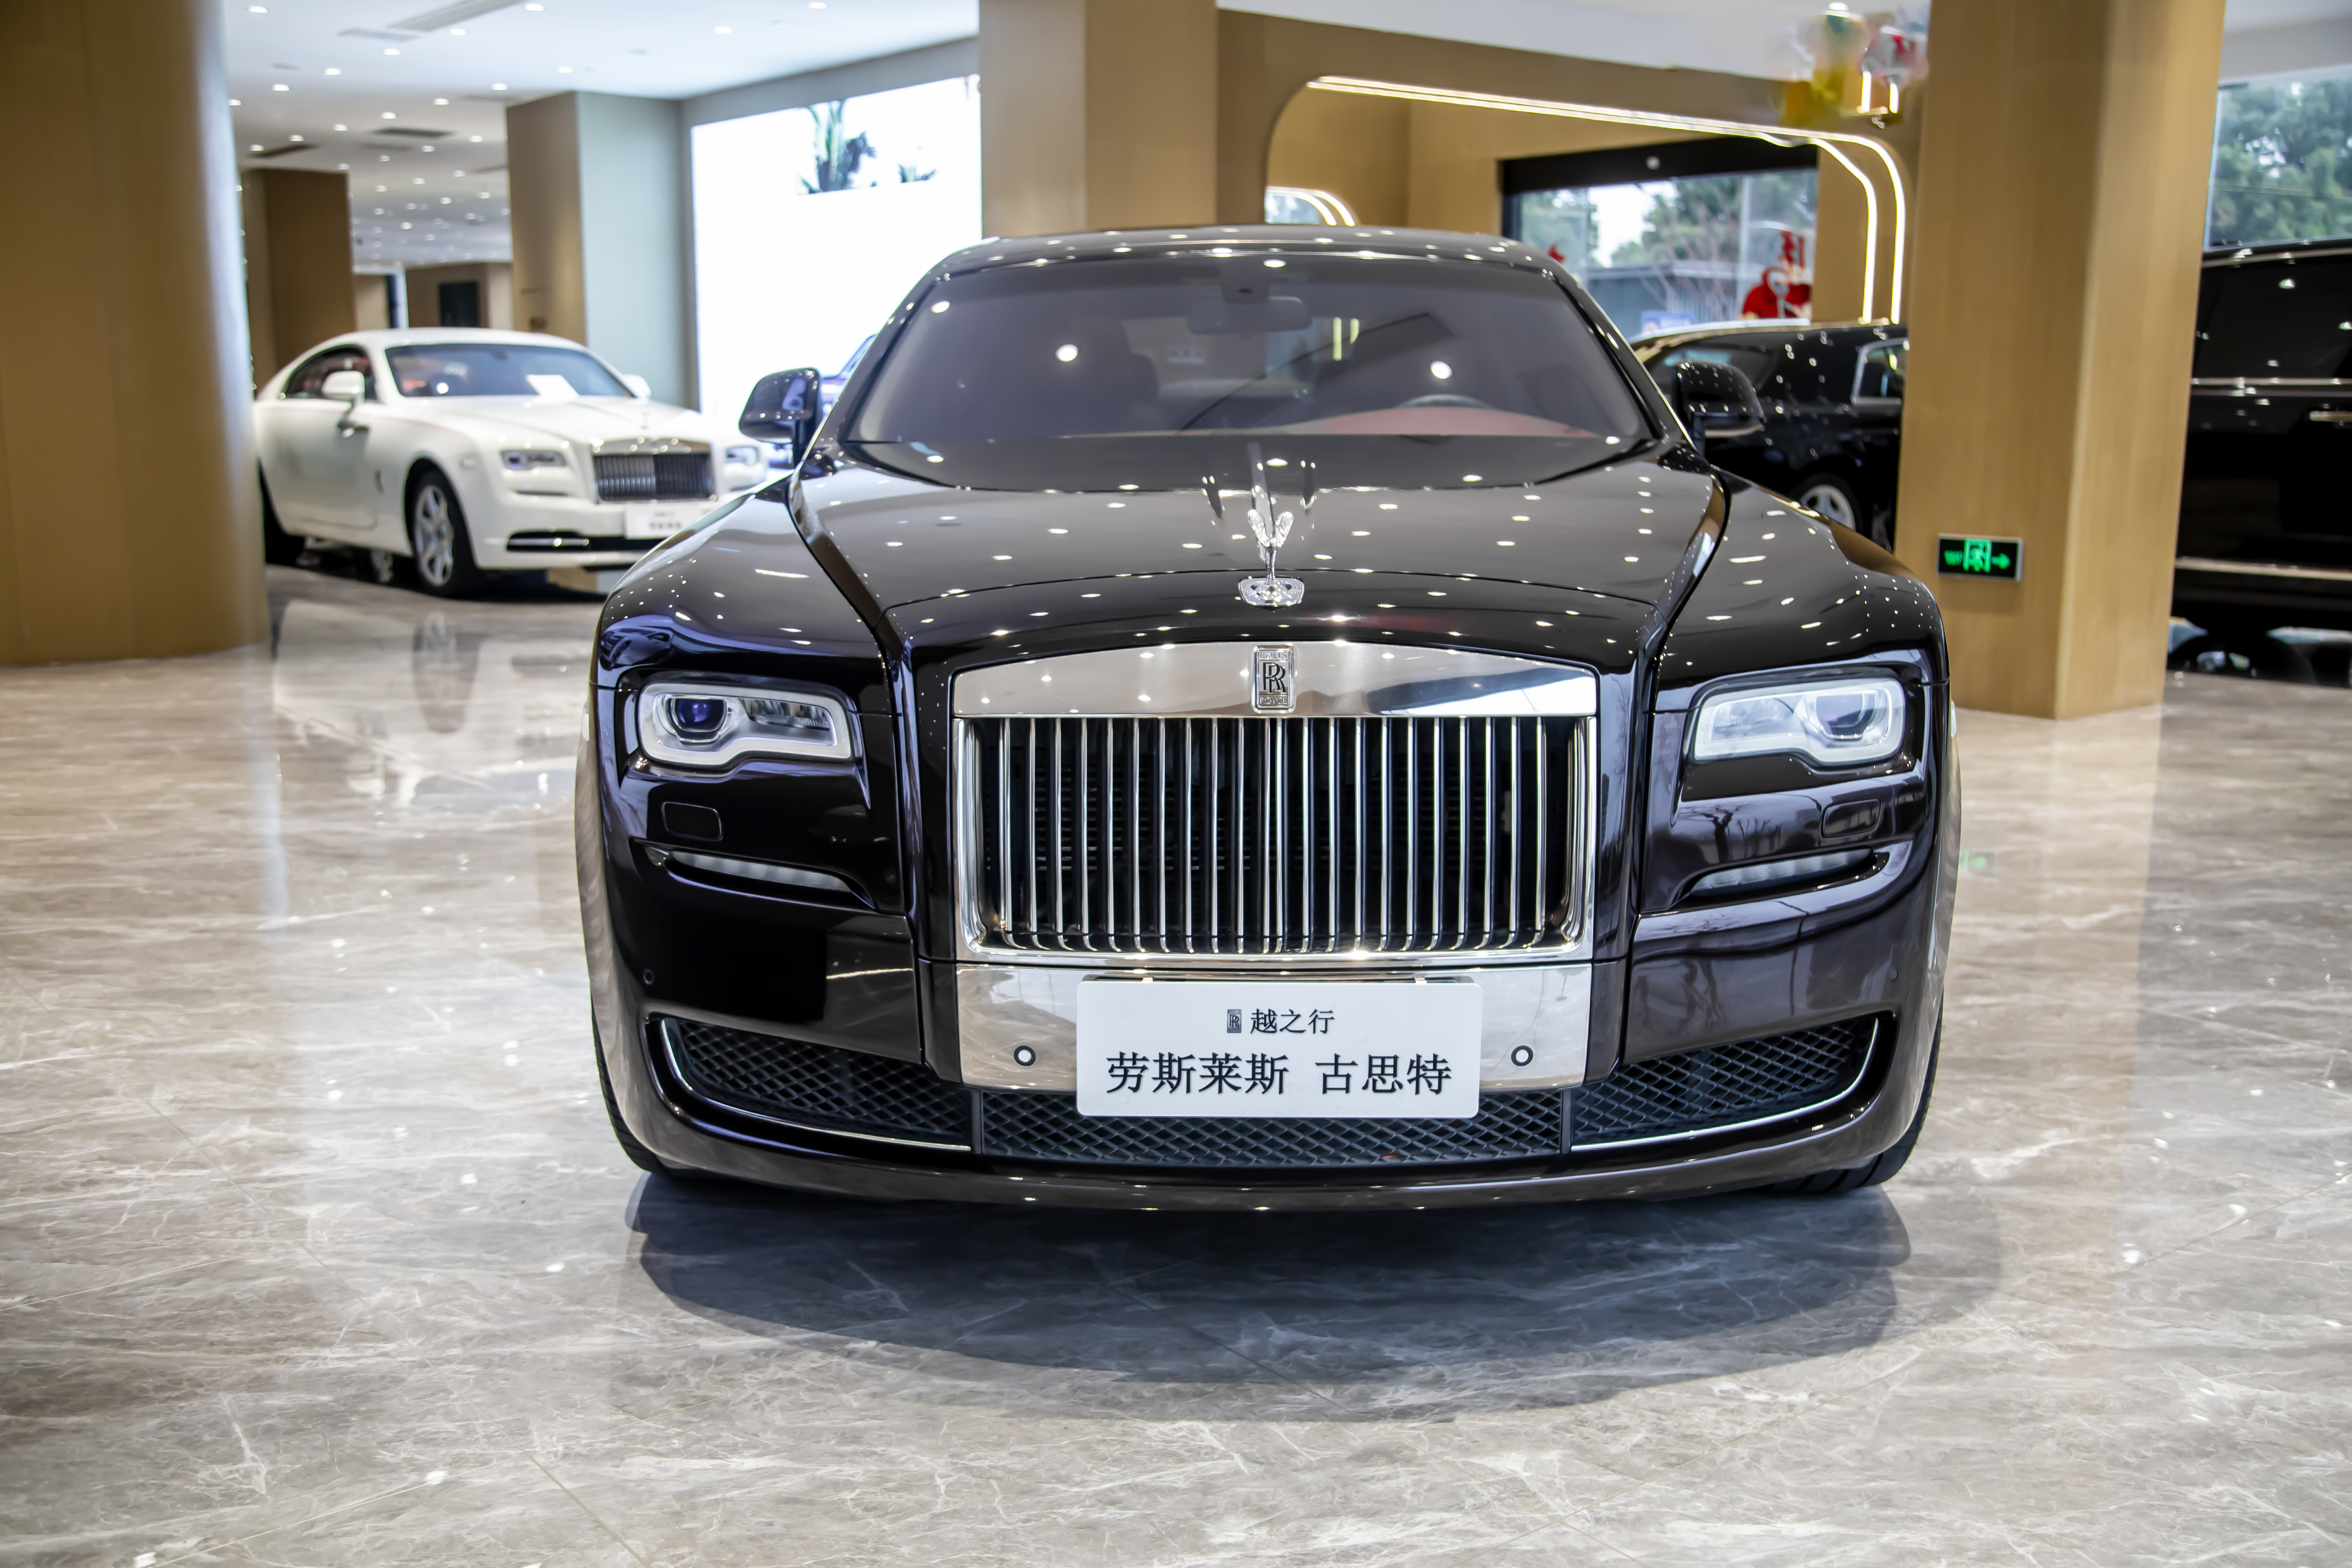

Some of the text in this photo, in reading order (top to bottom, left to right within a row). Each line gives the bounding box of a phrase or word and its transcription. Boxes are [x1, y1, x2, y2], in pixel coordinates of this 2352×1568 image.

[1262, 662, 1287, 694] RR
[1260, 696, 1288, 704] ROYCE
[1250, 1009, 1335, 1034] 越之行
[1106, 1051, 1452, 1095] 劳斯莱斯 古思特
